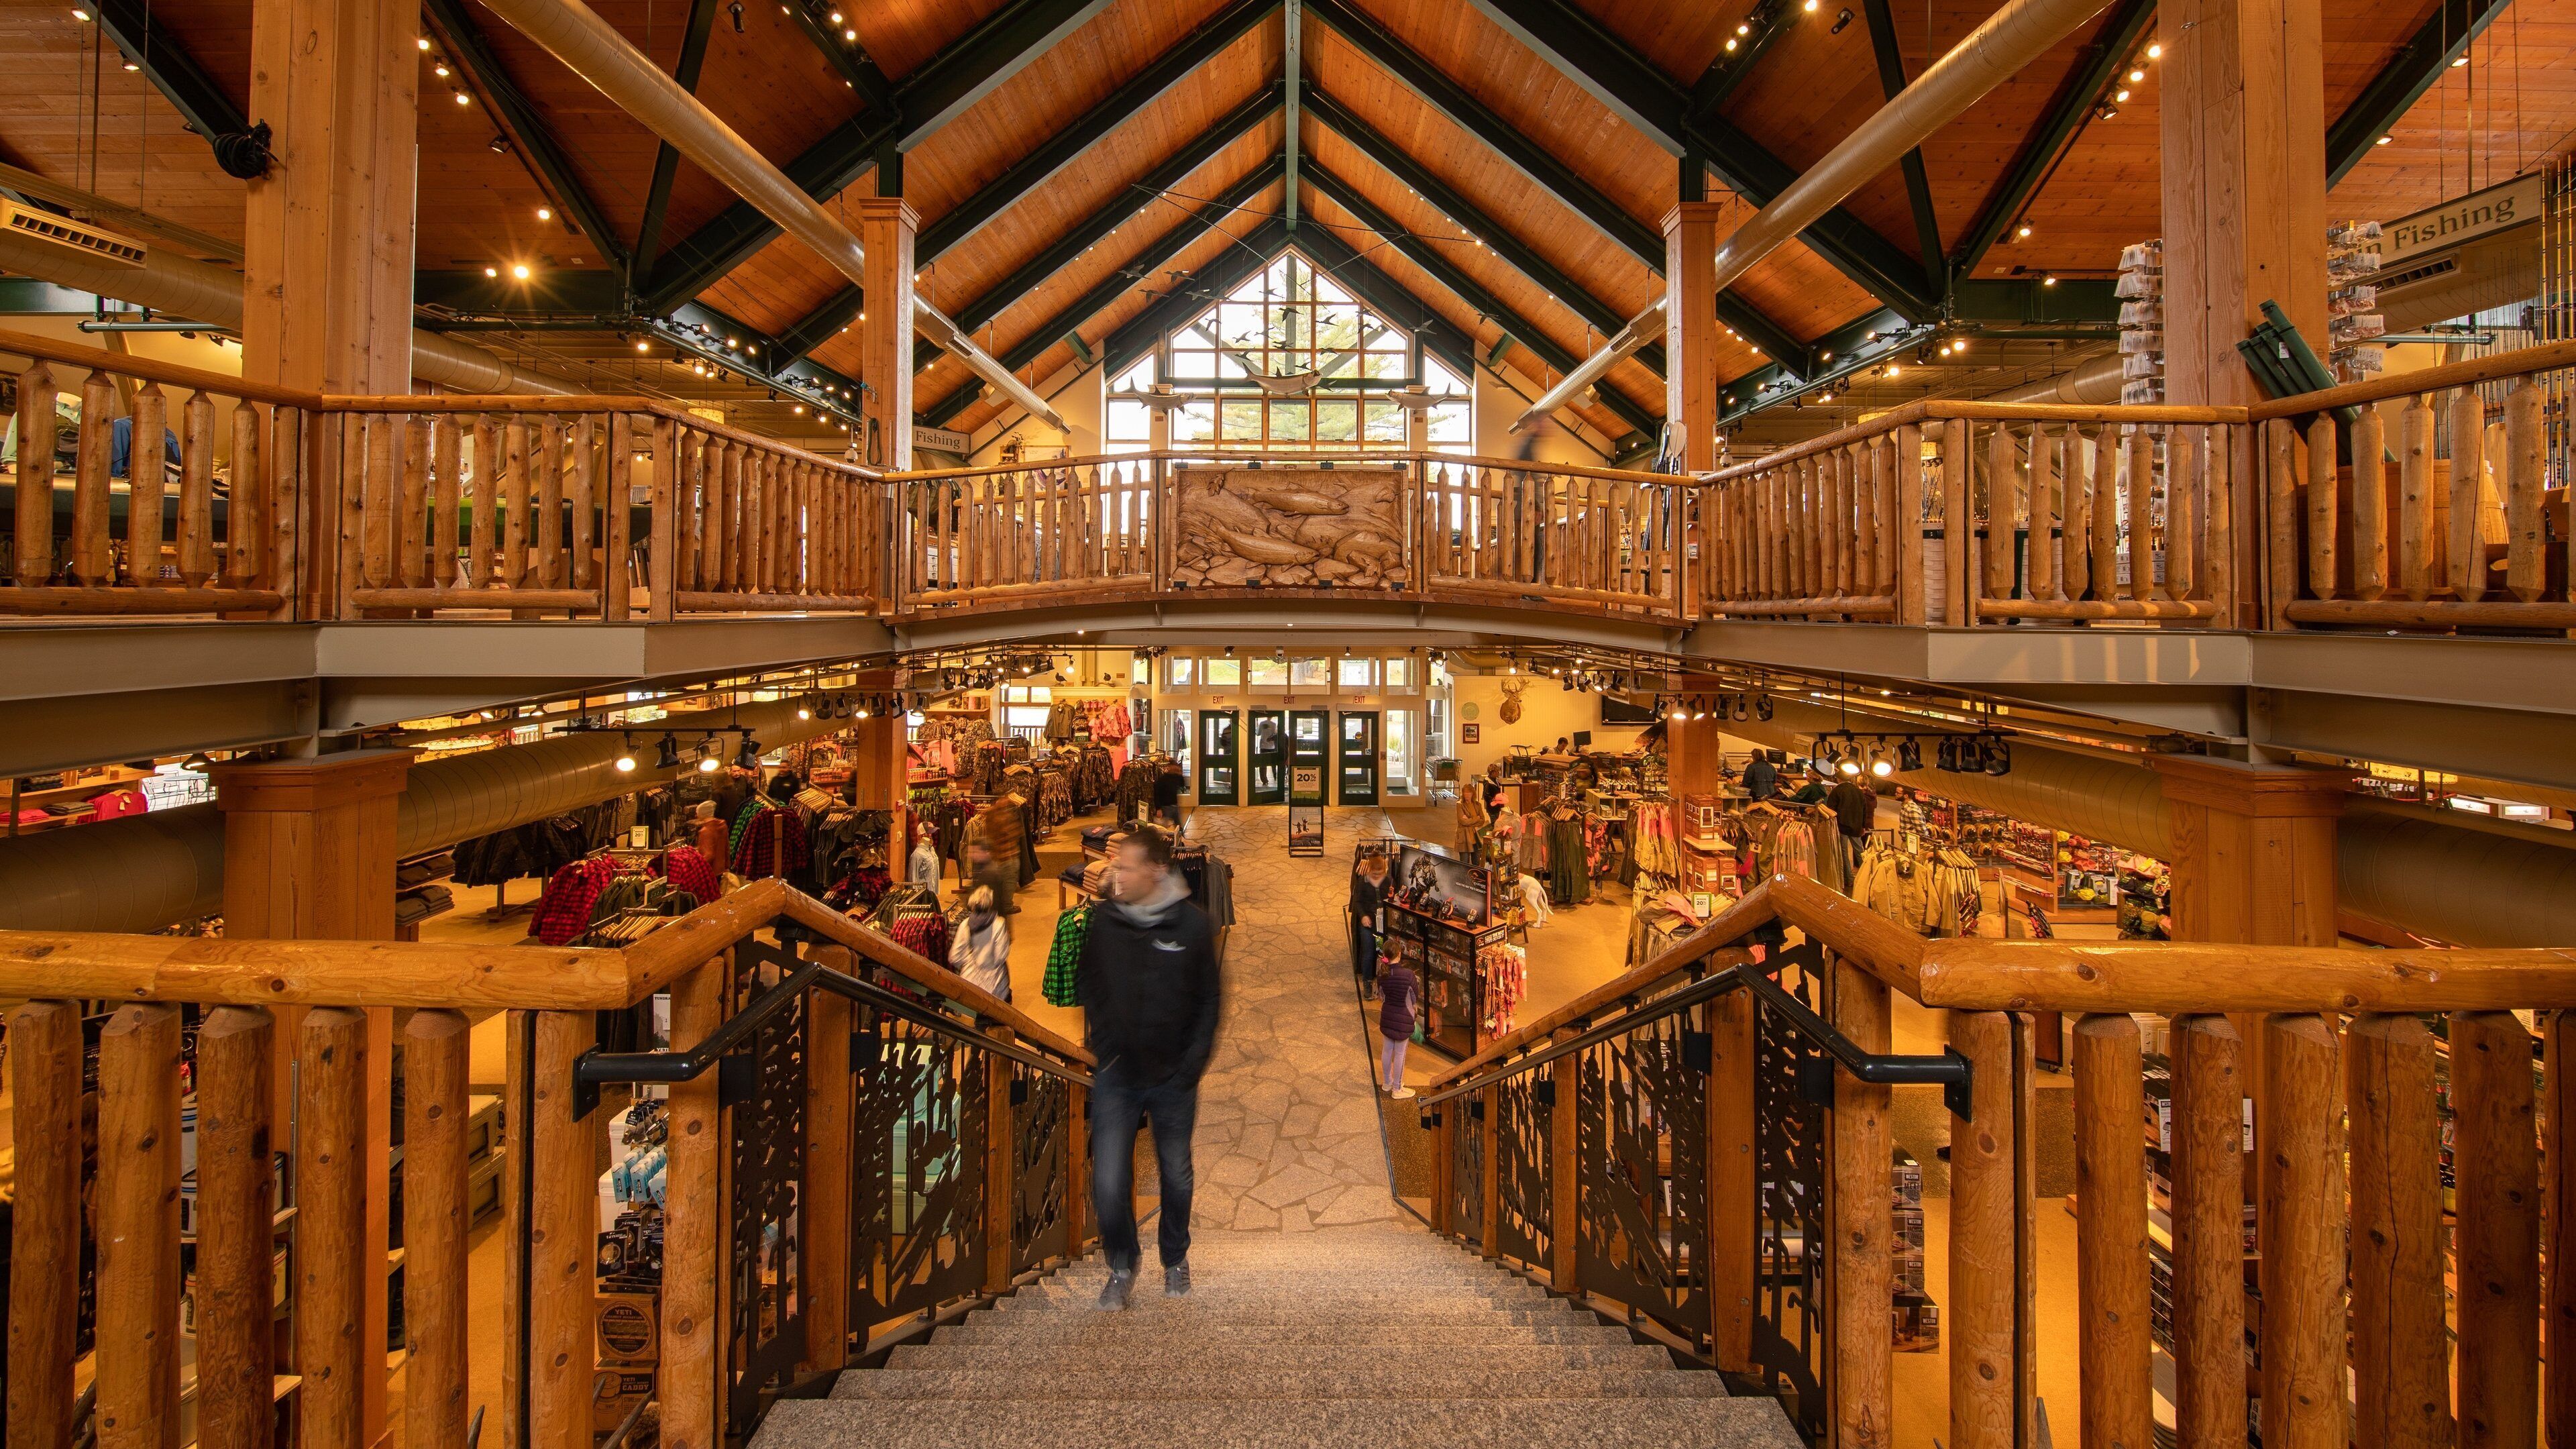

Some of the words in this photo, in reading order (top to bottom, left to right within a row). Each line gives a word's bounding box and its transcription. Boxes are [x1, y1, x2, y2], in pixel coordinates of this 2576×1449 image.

[2394, 196, 2515, 250] Fishing
[916, 430, 960, 450] Fishing
[1213, 696, 1224, 704] EXIT
[1284, 696, 1295, 704] EXIT
[1354, 696, 1365, 704] EXIT
